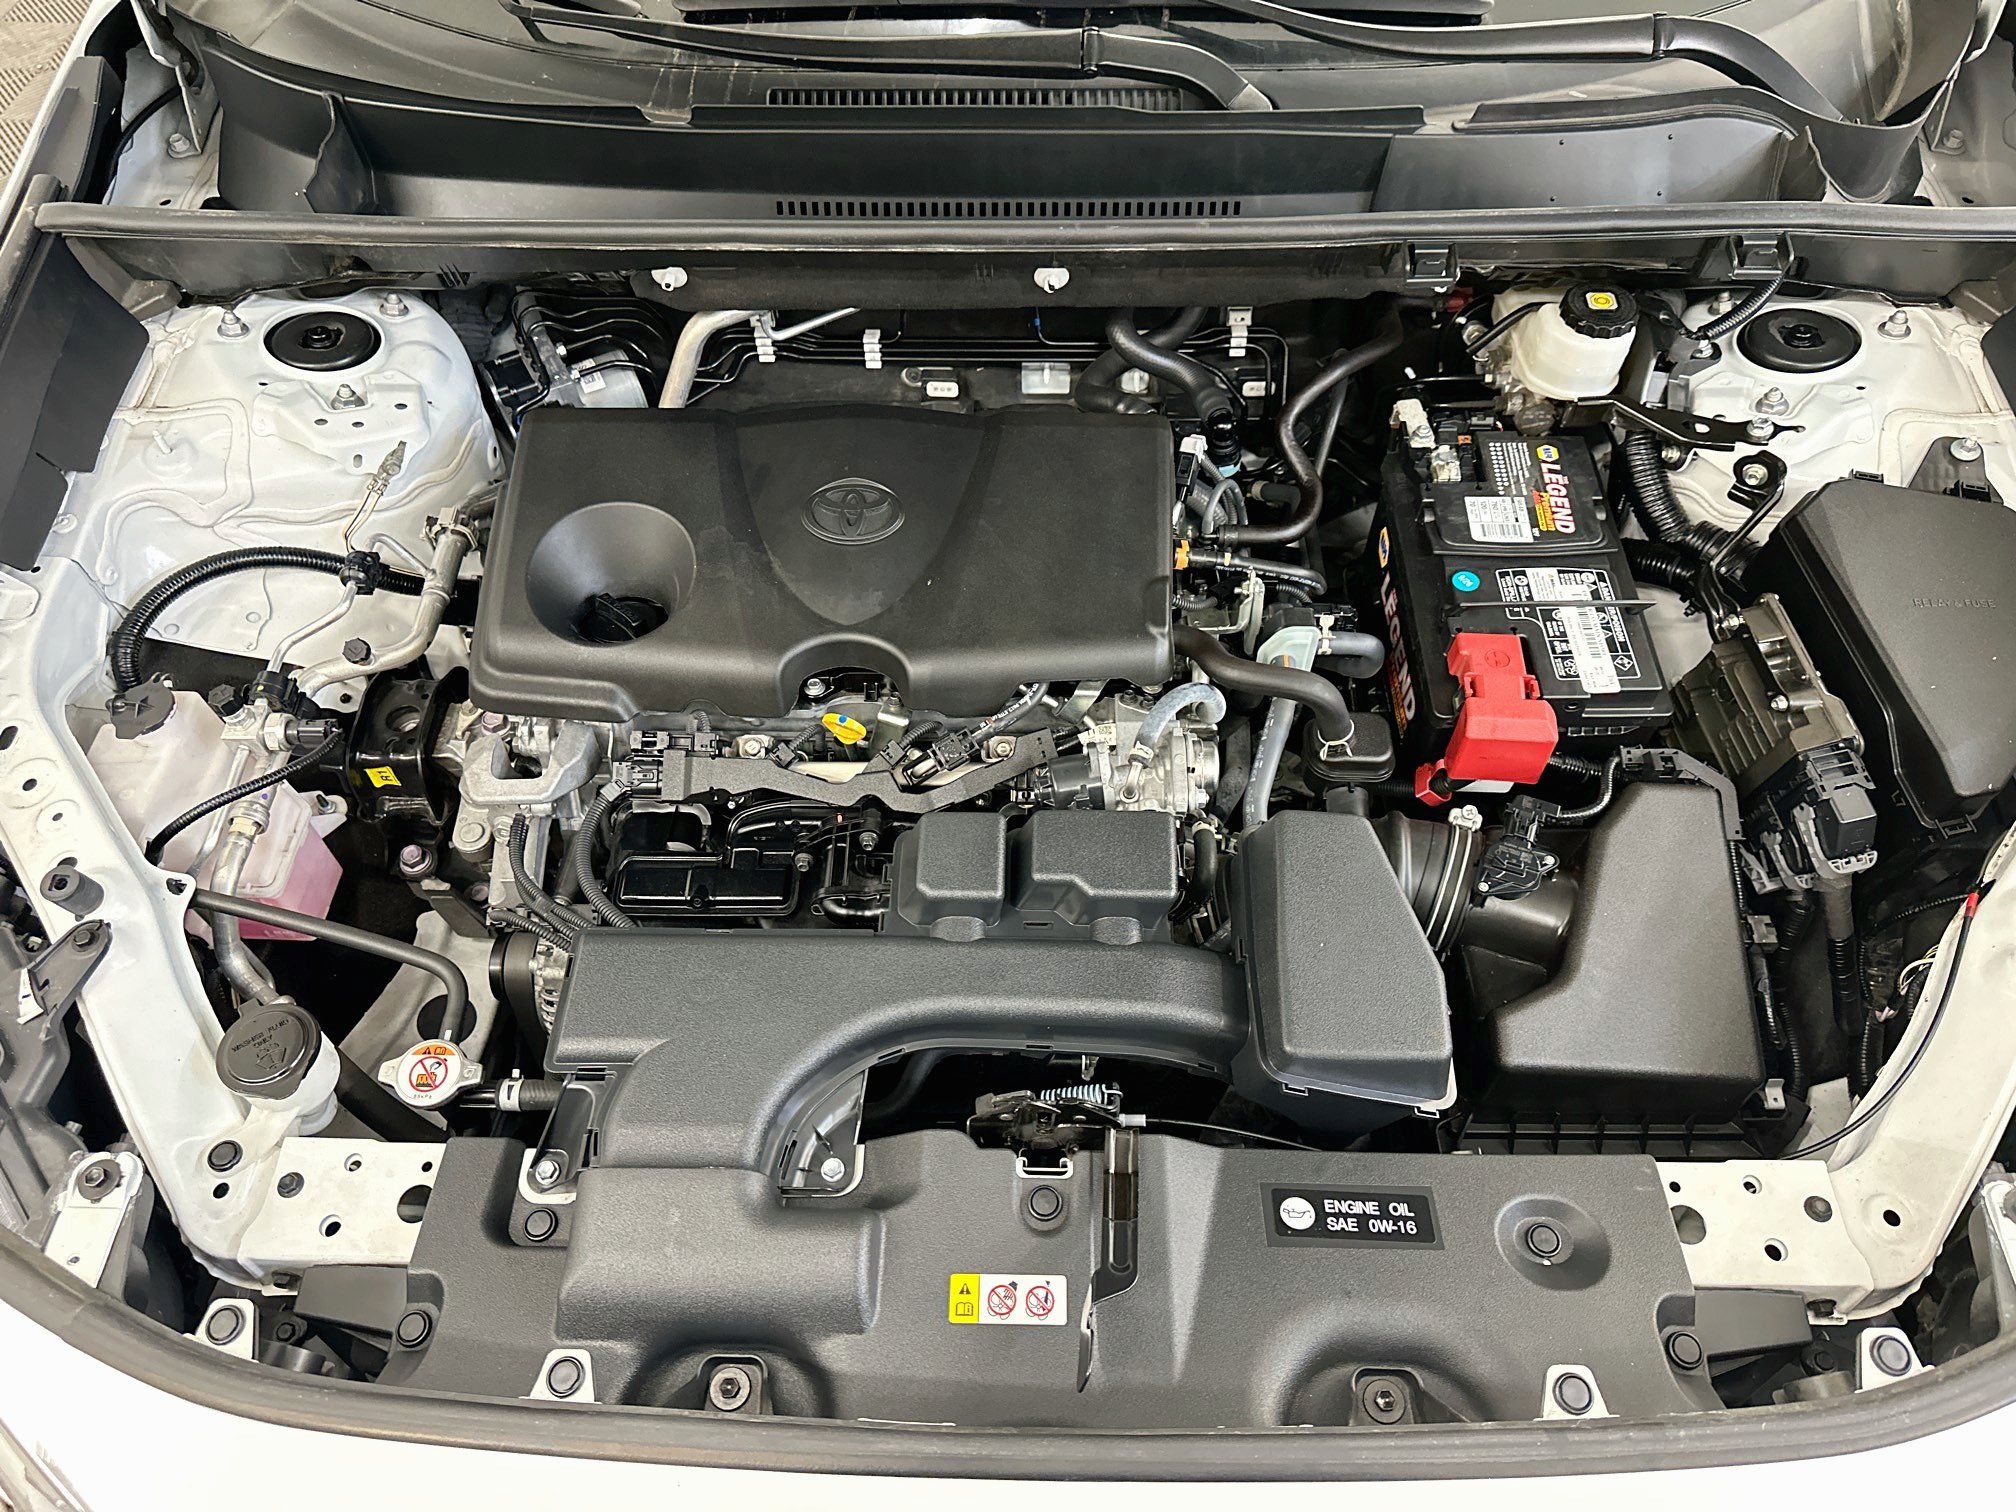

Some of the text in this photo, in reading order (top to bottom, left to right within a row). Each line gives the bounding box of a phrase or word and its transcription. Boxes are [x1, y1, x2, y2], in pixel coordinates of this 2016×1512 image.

[1540, 462, 1576, 534] LEGEND
[1540, 492, 1556, 531] Premium
[1912, 598, 1950, 607] RELAY
[1964, 600, 1996, 608] FUSE
[1380, 570, 1416, 721] LEGEND
[232, 1019, 290, 1052] WASHER FLUID
[254, 1034, 272, 1048] ONLY
[1324, 1200, 1416, 1217] ENGINE OIL
[1326, 1218, 1418, 1234] SAE 0W-16
